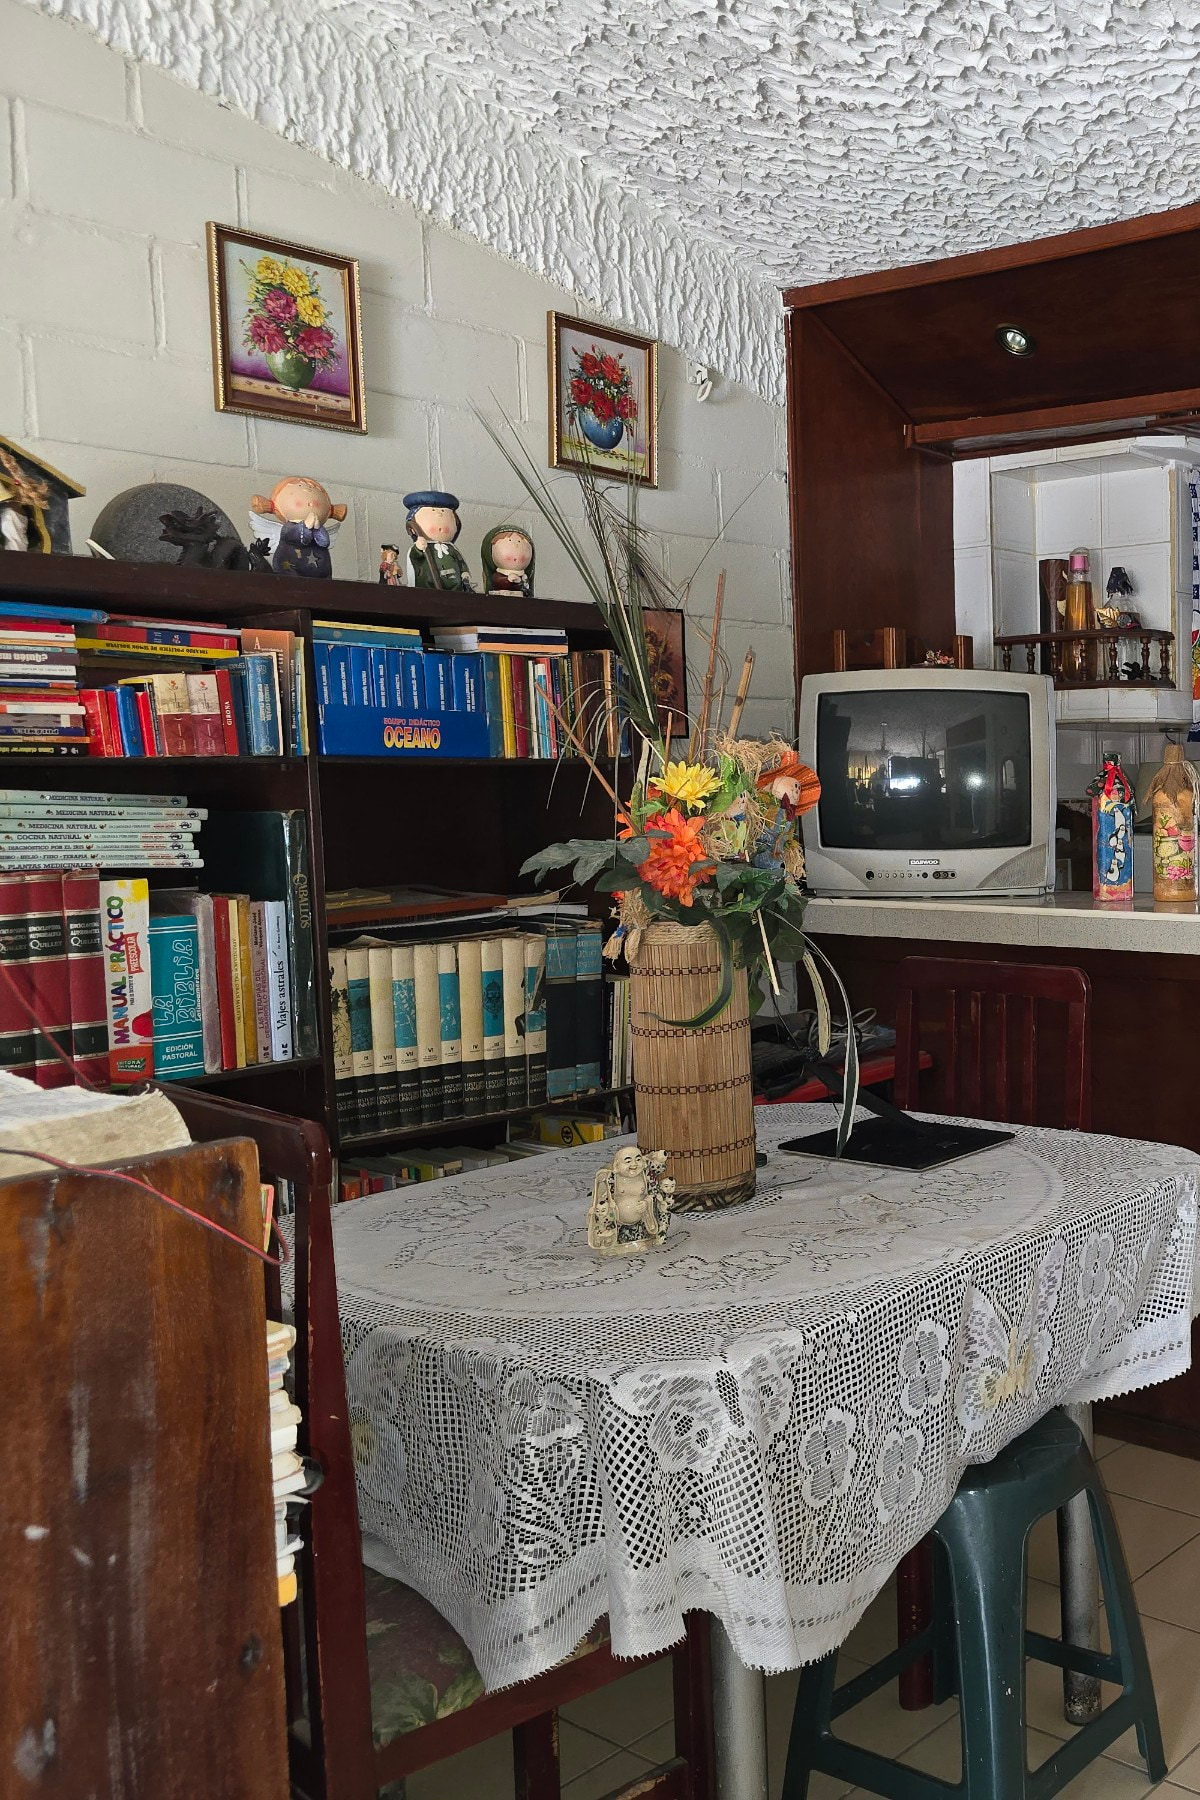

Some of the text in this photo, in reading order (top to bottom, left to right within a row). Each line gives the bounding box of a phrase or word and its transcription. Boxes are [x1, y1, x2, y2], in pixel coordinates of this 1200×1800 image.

[384, 725, 440, 749] OCEANO
[408, 718, 440, 727] DIDÁCTICO
[293, 873, 310, 929] CABALLOS
[30, 940, 62, 951] QUILLET
[127, 936, 139, 972] PREESCOLAR
[105, 896, 130, 1044] MANUAL PRÁCTICO
[260, 958, 268, 993] PERSONAL
[152, 994, 175, 1027] LA
[274, 960, 290, 1030] Viajes astrales
[162, 1050, 198, 1061] PASTORAL
[165, 1042, 194, 1053] EDICIÓN
